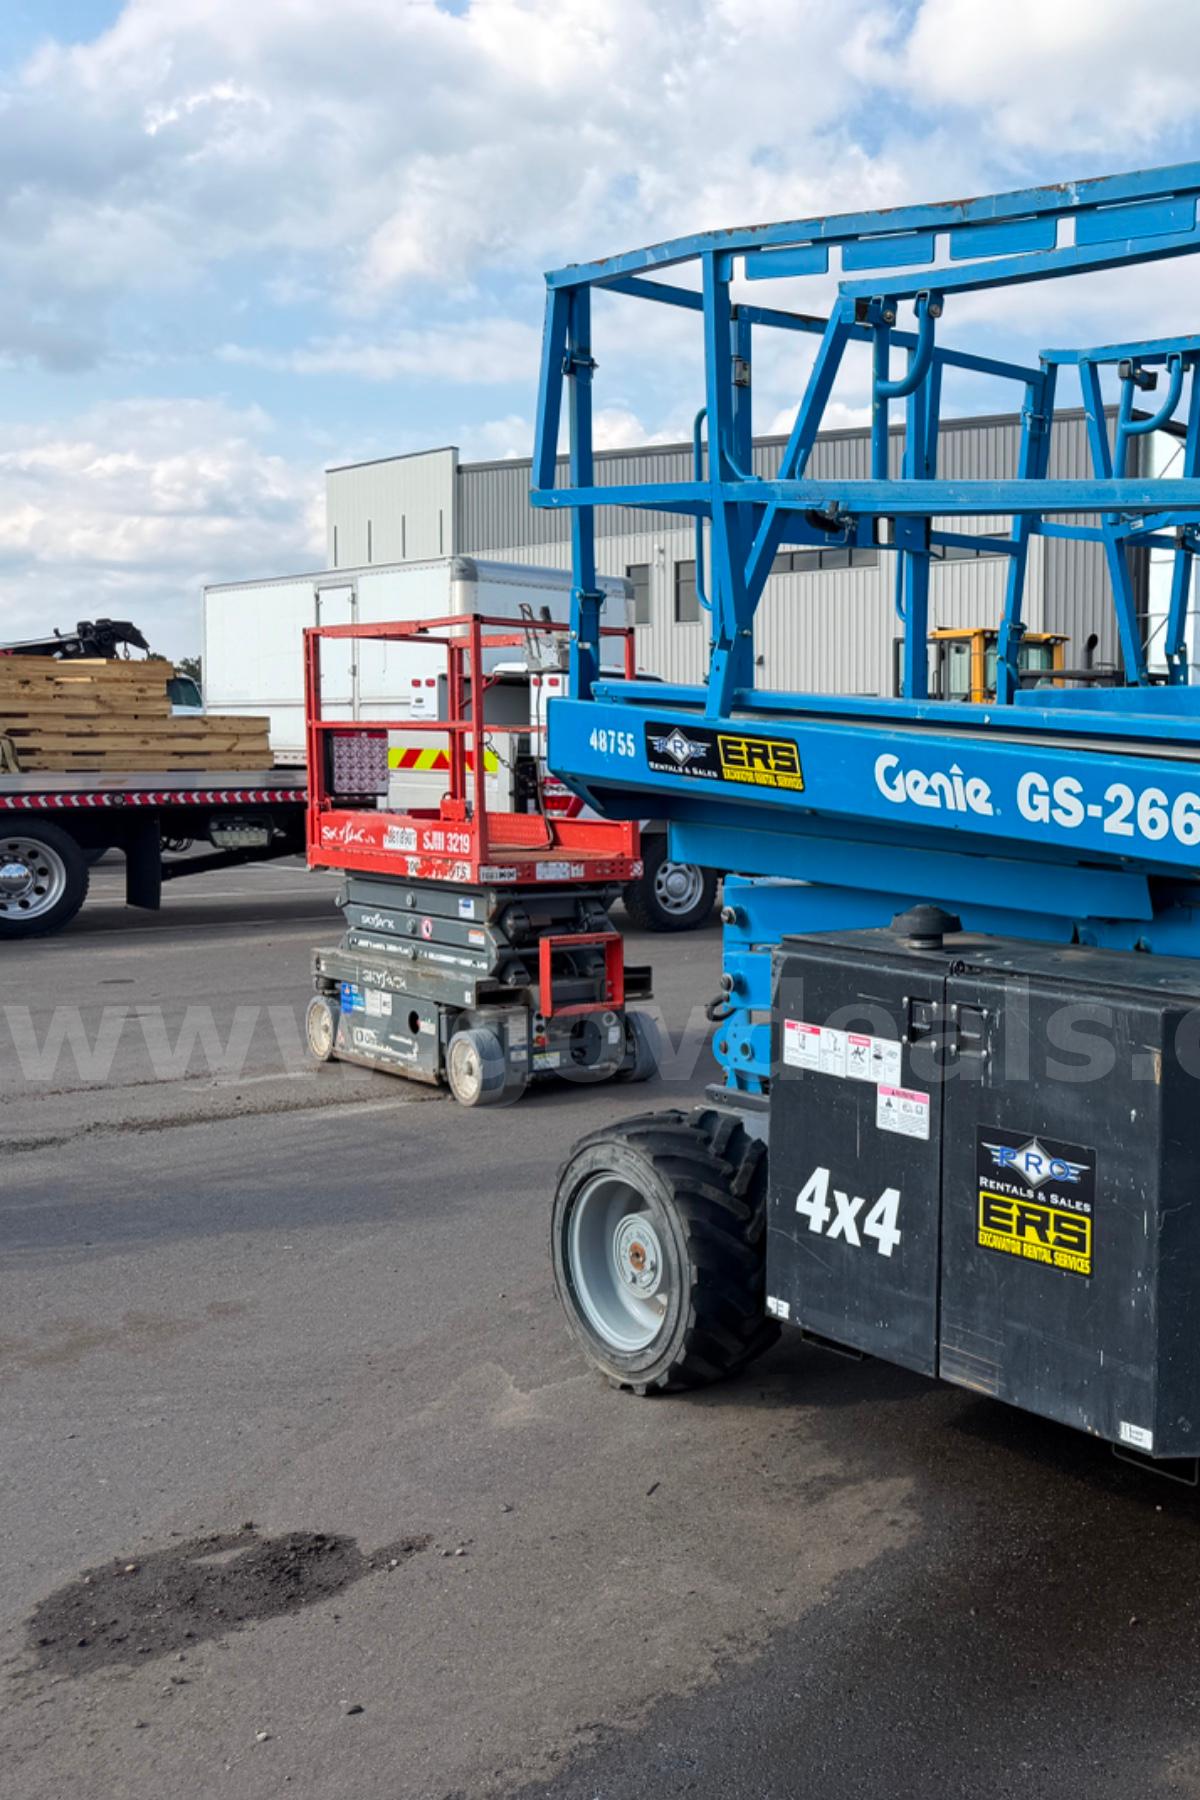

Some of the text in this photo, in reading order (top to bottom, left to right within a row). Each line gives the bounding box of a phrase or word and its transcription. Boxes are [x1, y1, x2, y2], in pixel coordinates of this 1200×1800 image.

[589, 728, 636, 758] 48755
[720, 740, 799, 775] ERS
[874, 753, 993, 816] Genie
[446, 832, 471, 854] 3219
[999, 1146, 1070, 1182] PRO
[795, 1166, 902, 1257] 4x4
[979, 1176, 1091, 1213] RENTALS & SALES
[982, 1195, 1087, 1255] ERS
[978, 1231, 1091, 1275] EXCAVATOR RENTAL SERVICES
